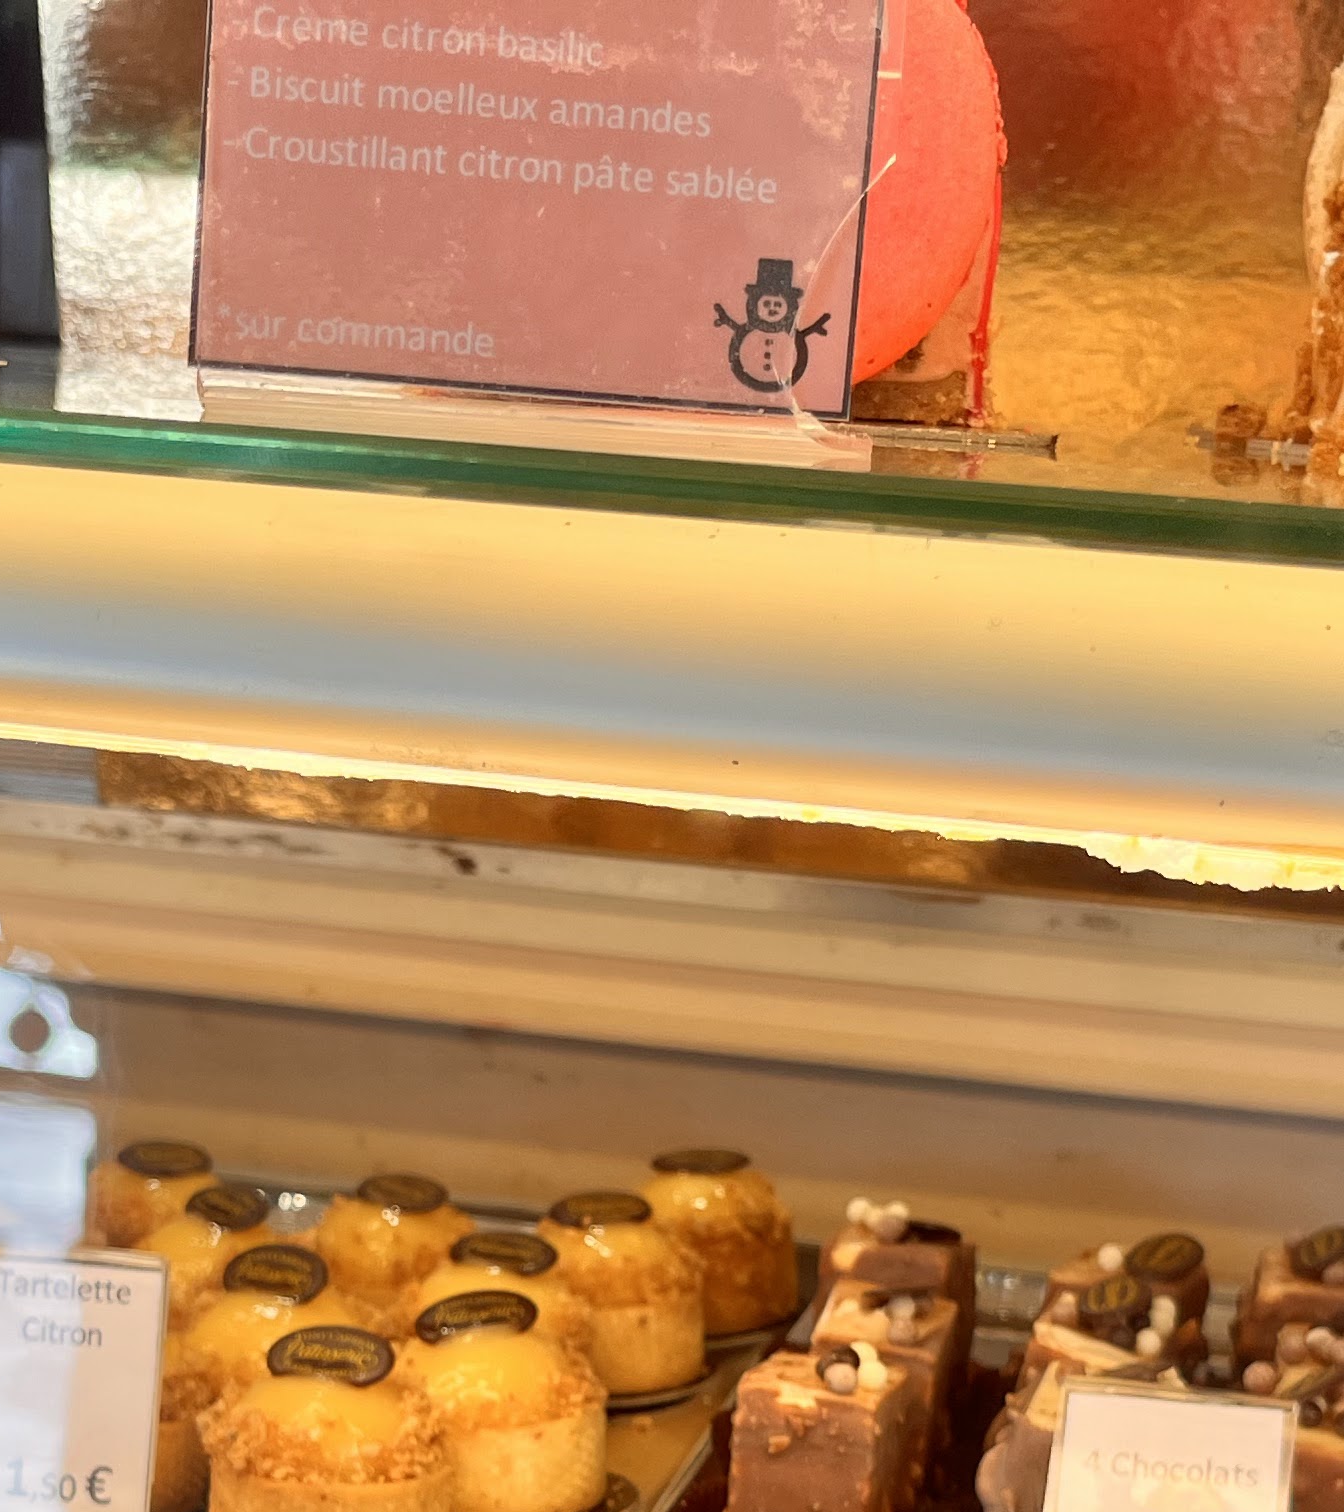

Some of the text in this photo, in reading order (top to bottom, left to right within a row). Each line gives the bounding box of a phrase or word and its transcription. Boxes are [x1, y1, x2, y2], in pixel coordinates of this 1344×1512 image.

[253, 6, 369, 47] Crème
[382, 17, 487, 57] citron
[497, 25, 605, 68] basilic
[249, 65, 366, 108] Biscuit
[378, 82, 539, 123] moelleux
[549, 99, 712, 138] amandes
[245, 126, 448, 176] Croustillant
[459, 145, 563, 184] citron
[574, 155, 654, 195] pâte
[666, 163, 778, 205] sablée
[298, 317, 497, 358] commande
[22, 1315, 103, 1347] Citron
[6, 1456, 114, 1506] 1,50 €
[1111, 1452, 1259, 1489] Chocolats
